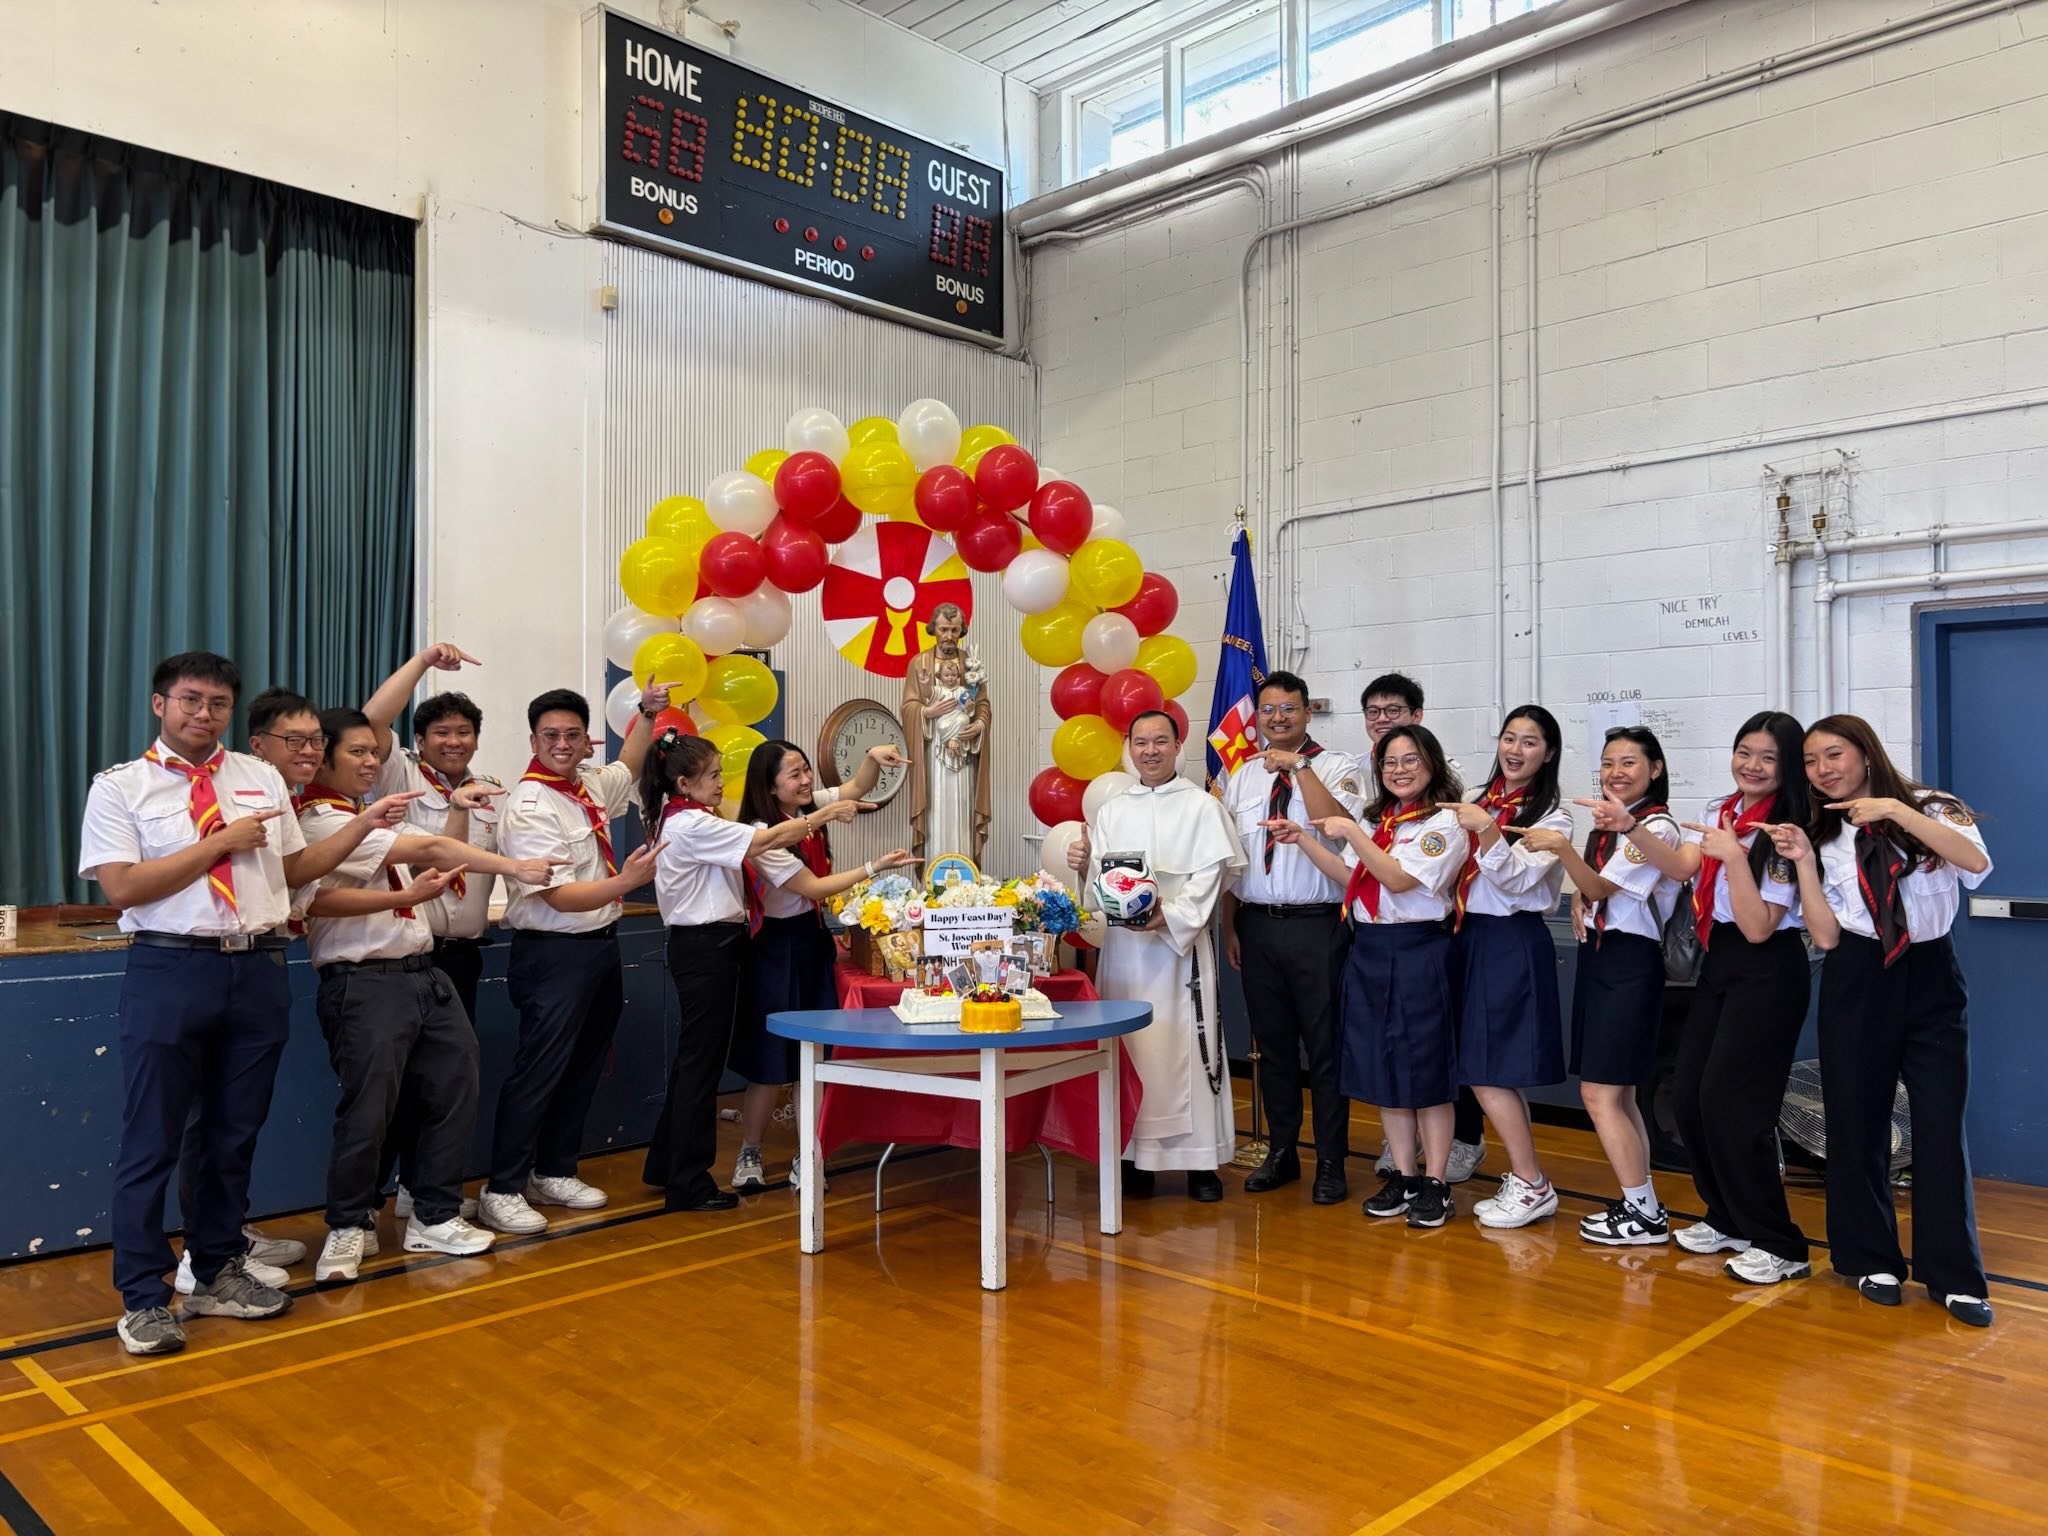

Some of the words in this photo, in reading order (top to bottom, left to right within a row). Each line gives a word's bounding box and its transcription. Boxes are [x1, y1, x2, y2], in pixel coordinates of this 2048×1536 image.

[626, 39, 702, 103] HOME
[928, 159, 991, 209] GUEST
[631, 176, 698, 215] BONUS
[794, 247, 855, 282] PERIOD
[936, 274, 984, 304] BONUS
[1723, 631, 1749, 641] LEVEL
[1620, 689, 1642, 700] CLUB
[854, 722, 863, 734] 11
[865, 718, 876, 730] 12
[880, 723, 885, 735] 1
[845, 735, 856, 747] 10
[888, 734, 895, 745] 2
[840, 749, 848, 760] 9
[844, 765, 851, 777] 8
[880, 778, 887, 789] 5
[930, 913, 960, 925] Happy
[961, 912, 986, 922] Feast
[987, 912, 1007, 923] Day!
[939, 933, 950, 942] St.
[952, 932, 983, 943] Joseph
[984, 932, 999, 941] the
